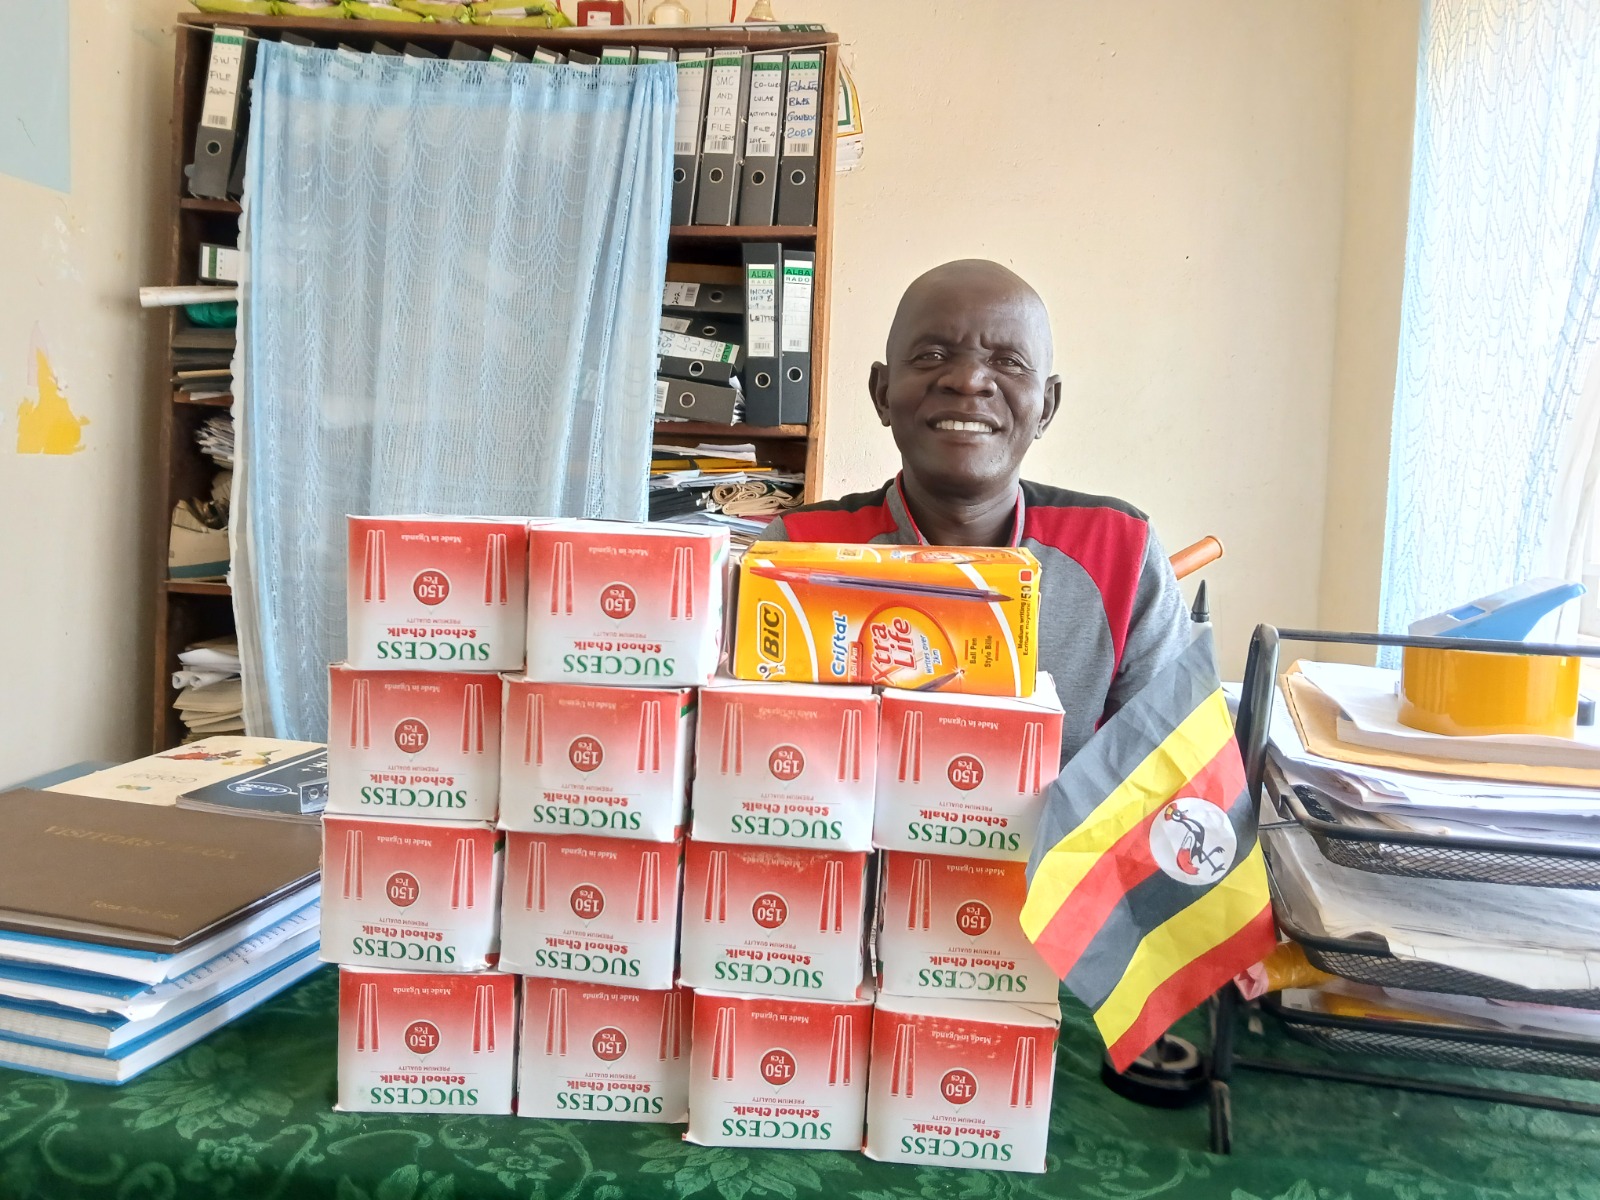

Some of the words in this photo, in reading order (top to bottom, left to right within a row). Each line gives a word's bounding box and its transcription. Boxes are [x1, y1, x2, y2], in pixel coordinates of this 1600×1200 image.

[791, 61, 818, 70] ALBA
[711, 123, 732, 132] FILE
[751, 270, 773, 278] ALBA
[786, 268, 811, 276] ALBA
[423, 576, 439, 584] Pcs
[419, 585, 445, 598] 150
[605, 598, 631, 611] 150
[387, 628, 426, 637] Chalk
[431, 629, 477, 638] School
[574, 641, 613, 651] Chalk
[617, 642, 662, 653] School
[888, 618, 914, 668] Life
[377, 641, 490, 661] SUCCESS
[872, 624, 893, 685] Xtra
[563, 654, 675, 677] SUCCESS
[978, 721, 999, 729] Made
[400, 733, 424, 745] 150
[578, 742, 592, 750] Pcs
[573, 751, 599, 764] 150
[779, 751, 793, 759] Pcs
[774, 759, 799, 773] 150
[958, 761, 972, 769] Pcs
[370, 774, 406, 784] Chalk
[410, 776, 454, 786] School
[953, 769, 978, 783] 150
[361, 786, 467, 808] SUCCESS
[544, 792, 580, 804] Chalk
[584, 796, 628, 807] School
[742, 802, 780, 812] Chalk
[784, 804, 829, 816] School
[533, 805, 642, 830] SUCCESS
[919, 810, 957, 822] Chalk
[962, 814, 1008, 828] School
[731, 815, 842, 840] SUCCESS
[413, 838, 432, 847] Made
[908, 822, 1021, 851] SUCCESS
[985, 868, 1005, 876] Made
[391, 886, 414, 900] 150
[579, 890, 594, 898] Pcs
[575, 898, 599, 912] 150
[967, 907, 981, 915] Pcs
[758, 908, 782, 922] 150
[962, 915, 987, 928] 150
[362, 925, 397, 937] Chalk
[401, 929, 443, 941] School
[545, 937, 582, 950] Chalk
[586, 942, 628, 954] School
[353, 937, 456, 963] SUCCESS
[725, 949, 763, 961] Chalk
[536, 949, 641, 977] SUCCESS
[767, 952, 811, 965] School
[930, 956, 968, 967] Chalk
[971, 959, 1015, 970] School
[714, 961, 823, 989] SUCCESS
[918, 968, 1028, 992] SUCCESS
[620, 994, 639, 1002] Made
[789, 1015, 809, 1023] Made
[410, 1035, 435, 1047] 150
[602, 1033, 616, 1041] Pcs
[598, 1042, 622, 1053] 150
[771, 1056, 785, 1064] Pcs
[766, 1064, 791, 1077] 150
[380, 1075, 417, 1083] Chalk
[422, 1076, 465, 1085] School
[951, 1075, 966, 1083] Pcs
[567, 1080, 604, 1091] Chalk
[608, 1083, 651, 1093] School
[946, 1083, 972, 1097] 150
[371, 1087, 478, 1105] SUCCESS
[557, 1092, 663, 1113] SUCCESS
[733, 1106, 771, 1116] Chalk
[775, 1108, 819, 1118] School
[722, 1118, 832, 1140] SUCCESS
[913, 1123, 952, 1135] Chalk
[955, 1126, 1001, 1138] School
[901, 1136, 1013, 1161] SUCCESS
